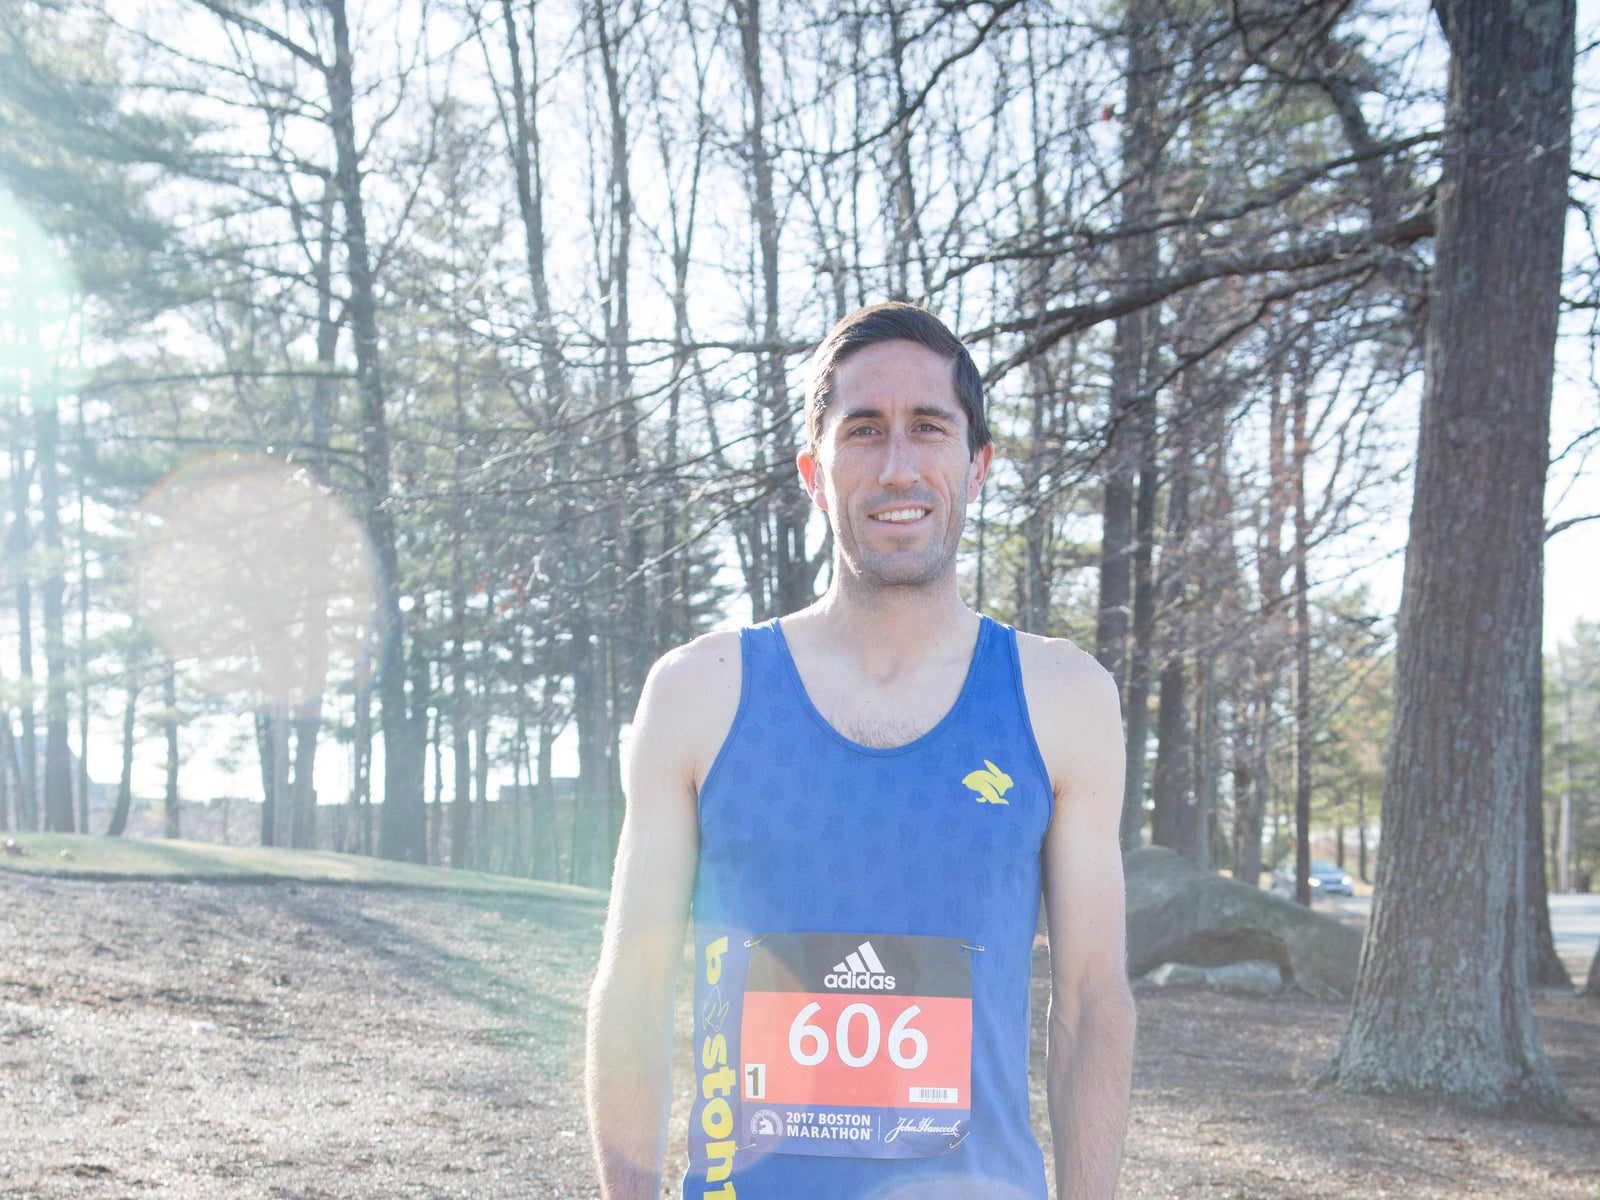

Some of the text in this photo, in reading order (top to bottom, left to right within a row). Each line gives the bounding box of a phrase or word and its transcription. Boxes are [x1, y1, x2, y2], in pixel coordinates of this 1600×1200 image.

[823, 971, 896, 990] adidas
[788, 1001, 929, 1070] 606
[746, 1066, 760, 1097] 1
[786, 1111, 815, 1124] 2017
[818, 1113, 871, 1126] BOSTON
[786, 1124, 871, 1140] MARATHON
